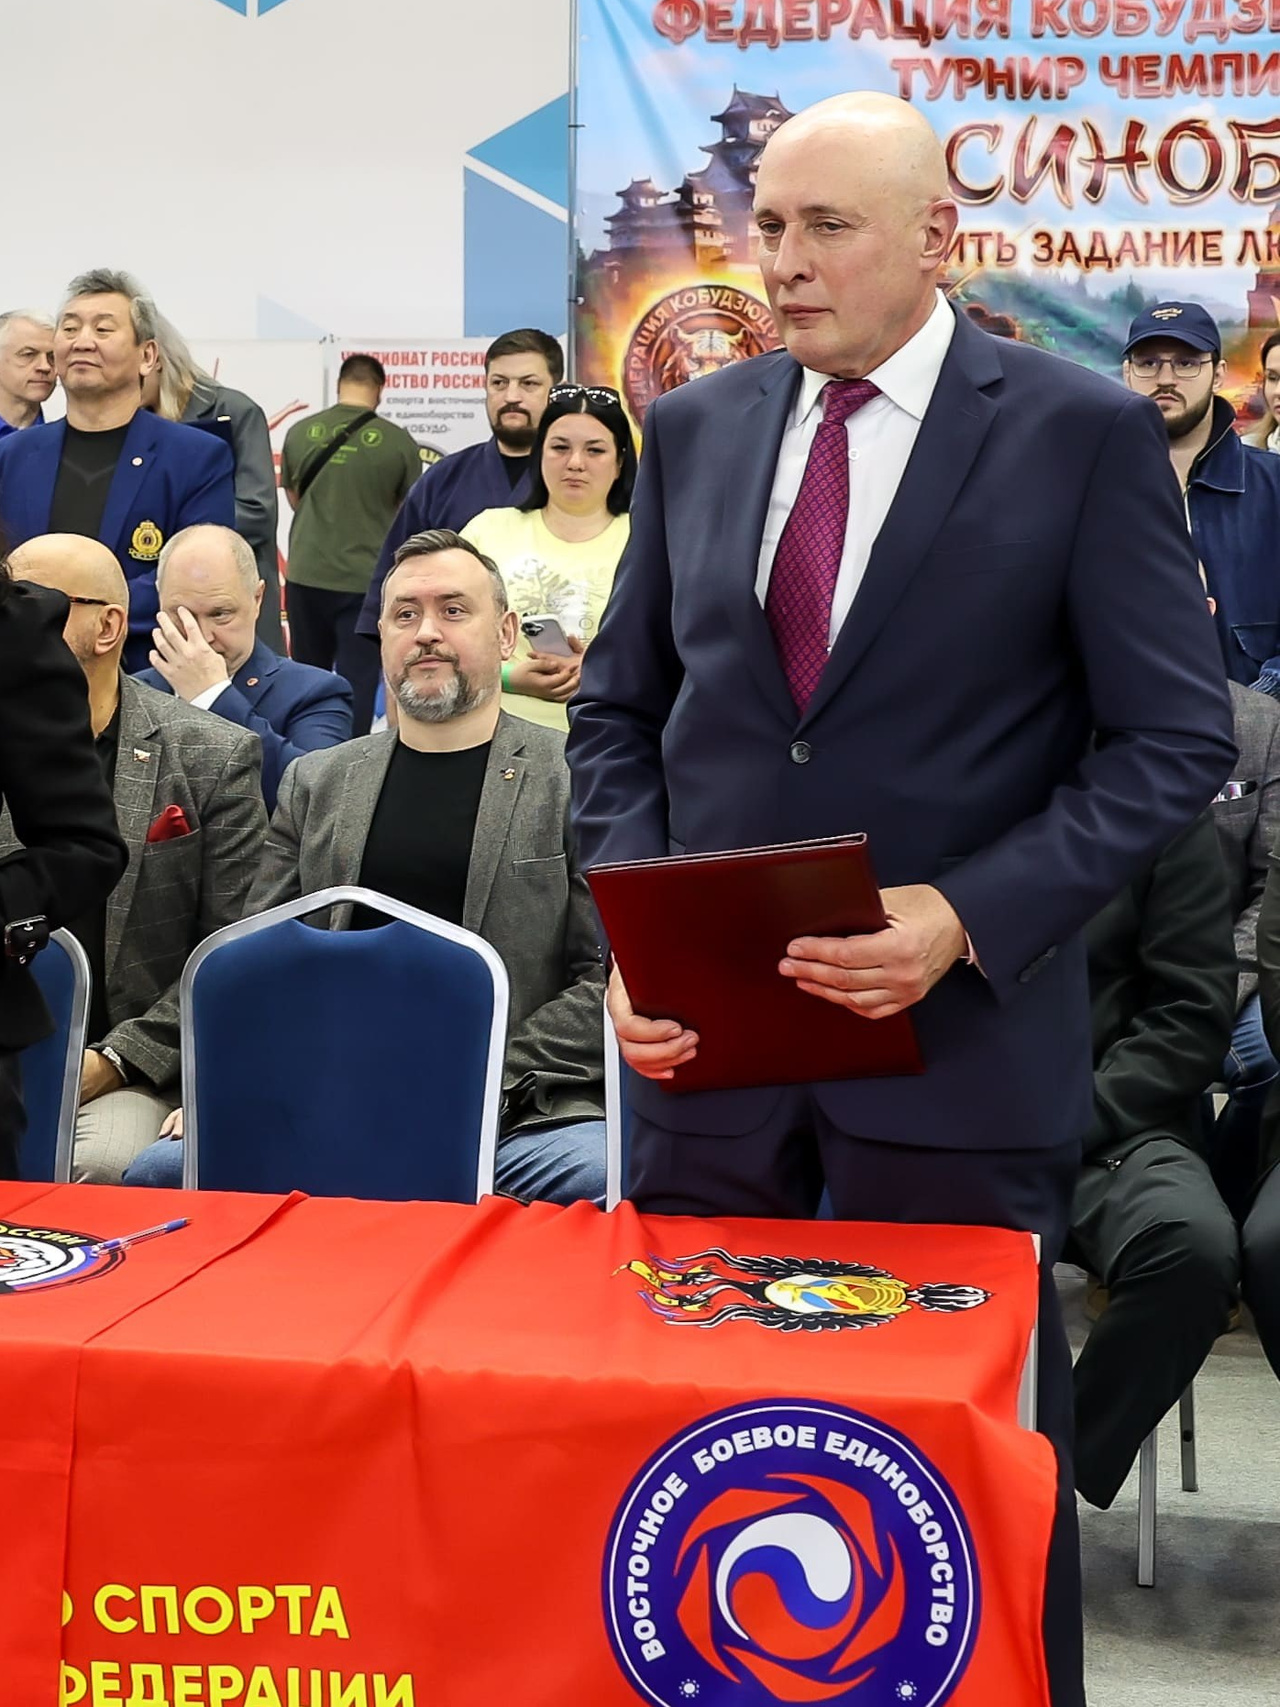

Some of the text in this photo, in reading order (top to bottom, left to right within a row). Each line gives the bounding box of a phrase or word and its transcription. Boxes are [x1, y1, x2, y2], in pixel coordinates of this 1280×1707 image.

[652, 0, 1280, 49] ФЕДЕРАЦИЯ КОБУДЗ
[892, 56, 1087, 100] ТУРНИР
[945, 114, 1280, 209] СИНОБ
[1032, 230, 1224, 273] ЗАДАНИЕ
[629, 305, 670, 410] ЕДЕРАЦИЯ
[627, 1424, 955, 1662] ВОСТОЧНОЕ БОЕВОЕ ЕДИНОБОРСТВО
[94, 1583, 351, 1640] СПОРТА
